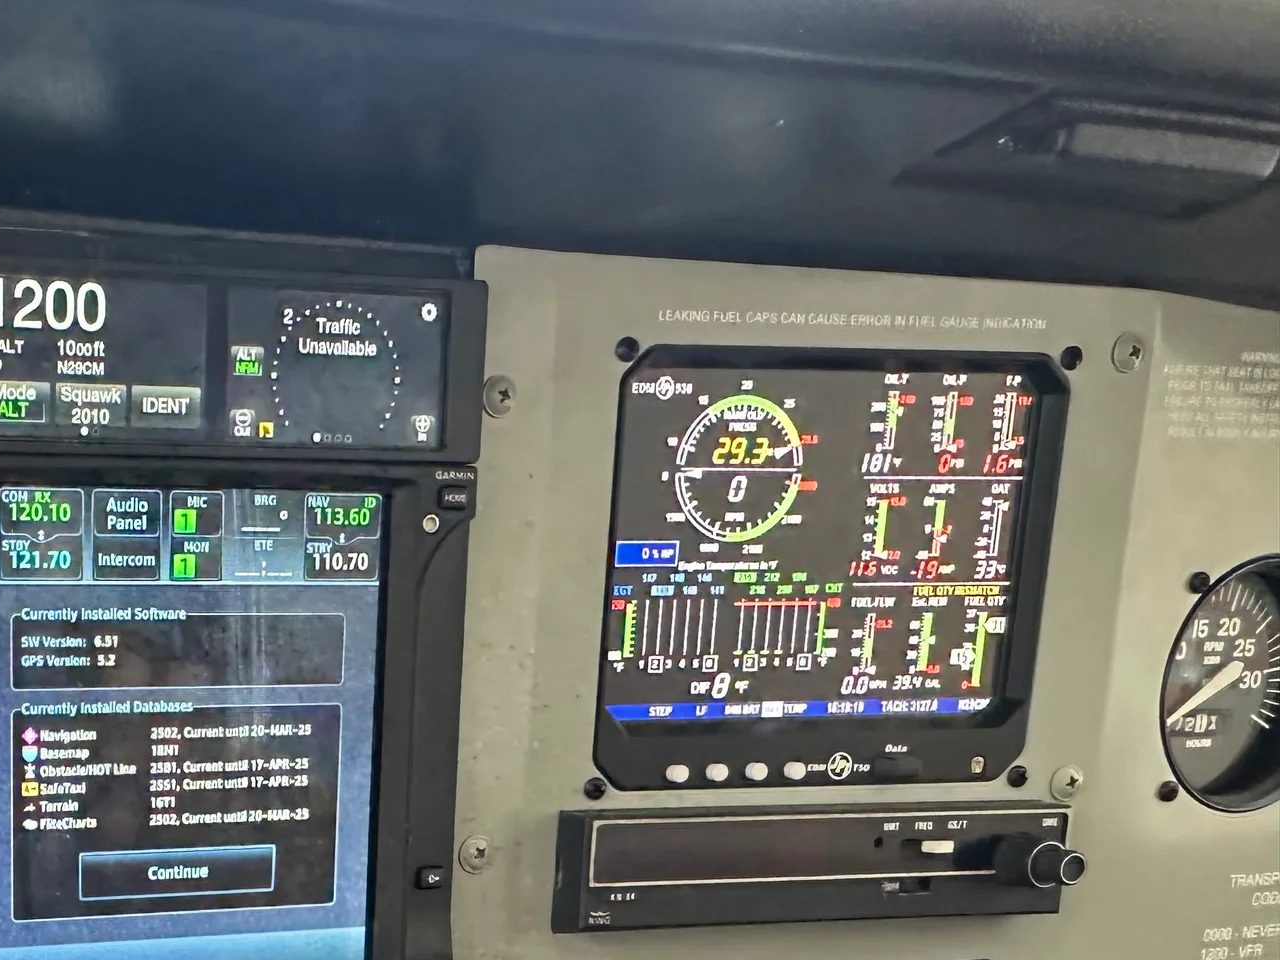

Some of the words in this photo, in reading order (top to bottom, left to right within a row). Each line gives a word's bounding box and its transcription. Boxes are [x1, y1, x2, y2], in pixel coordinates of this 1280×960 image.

[316, 317, 361, 337] Traffic
[658, 310, 711, 324] LEAKING
[713, 310, 743, 325] FUEL
[746, 311, 779, 326] CAPS
[781, 312, 806, 325] CAN
[808, 313, 847, 327] CAUSE
[850, 314, 892, 328] ERROR
[894, 315, 907, 328] IN
[940, 316, 981, 330] GAUGE
[299, 339, 377, 357] Unavailable
[57, 360, 106, 376] N29CM
[61, 387, 122, 405] Squawk
[142, 397, 189, 416] IDENT
[71, 407, 111, 426] 2010
[712, 437, 768, 466] 29.3
[9, 502, 71, 523] 120.10
[106, 496, 149, 513] Audio
[106, 515, 147, 531] Panel
[313, 507, 371, 527] 113.60
[9, 550, 72, 570] 121.70
[97, 552, 156, 569] Intercom
[312, 551, 369, 572] 110.70
[21, 608, 78, 623] Currently
[81, 607, 132, 622] Installed
[134, 606, 187, 621] Software
[1217, 617, 1241, 636] 20
[1232, 638, 1256, 657] 25
[1239, 670, 1262, 689] 30
[21, 703, 78, 718] Currently
[80, 702, 131, 716] Installed
[133, 700, 194, 715] Databases
[147, 865, 210, 881] Continue
[1239, 944, 1263, 958] VFR
